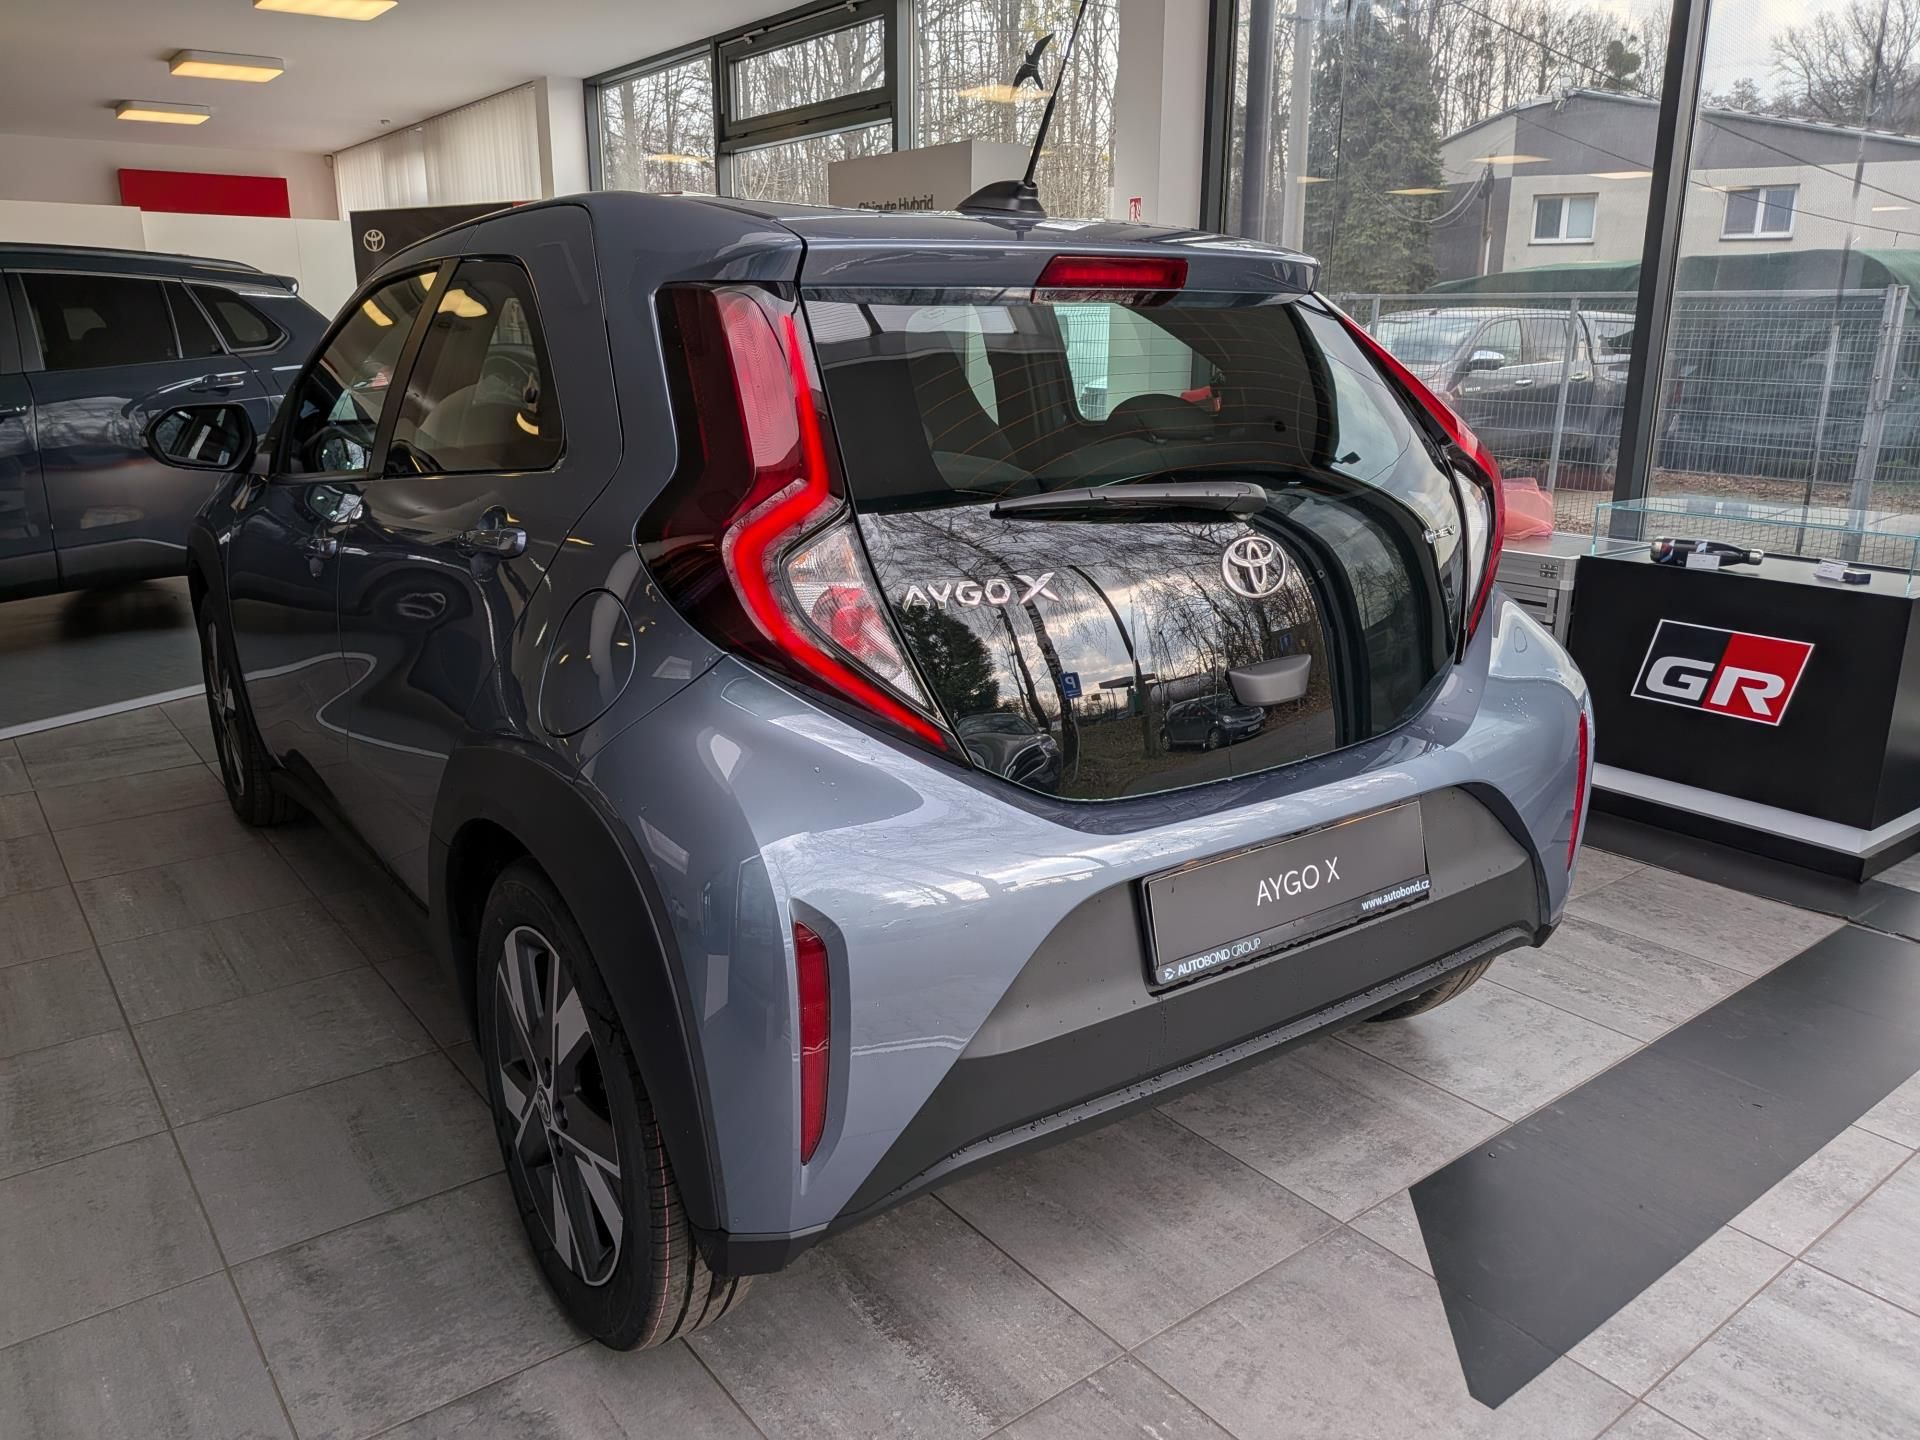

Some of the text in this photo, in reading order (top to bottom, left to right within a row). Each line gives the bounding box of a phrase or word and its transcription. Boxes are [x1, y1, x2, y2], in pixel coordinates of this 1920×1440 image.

[898, 194, 934, 210] Hybrid
[1645, 656, 1786, 716] GR
[1256, 856, 1340, 907] AYGO X
[1361, 879, 1431, 911] www.autobond.cz
[1178, 937, 1261, 977] AUTOBOND GROUP
